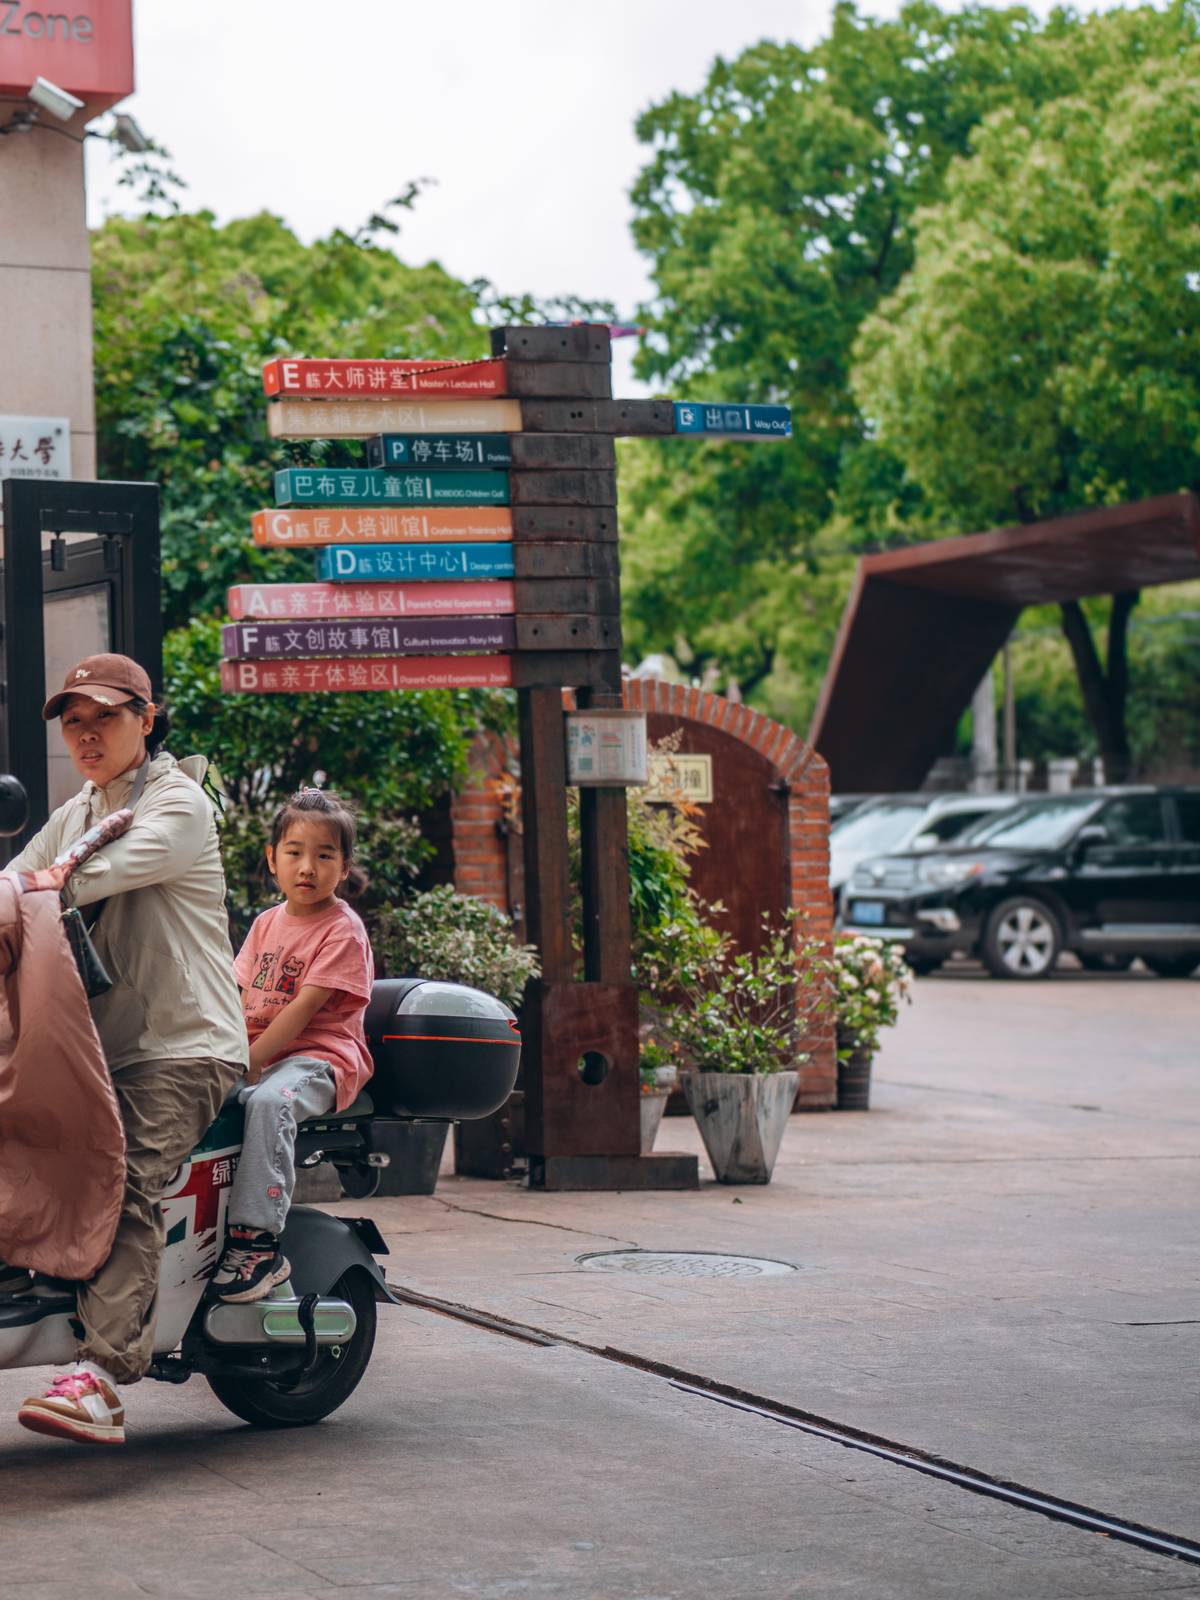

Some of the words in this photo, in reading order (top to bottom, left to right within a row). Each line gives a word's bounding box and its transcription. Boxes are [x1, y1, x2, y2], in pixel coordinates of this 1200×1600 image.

[706, 408, 741, 429] 出口
[412, 440, 474, 462] 停车场
[295, 475, 424, 498] 巴布豆儿童馆
